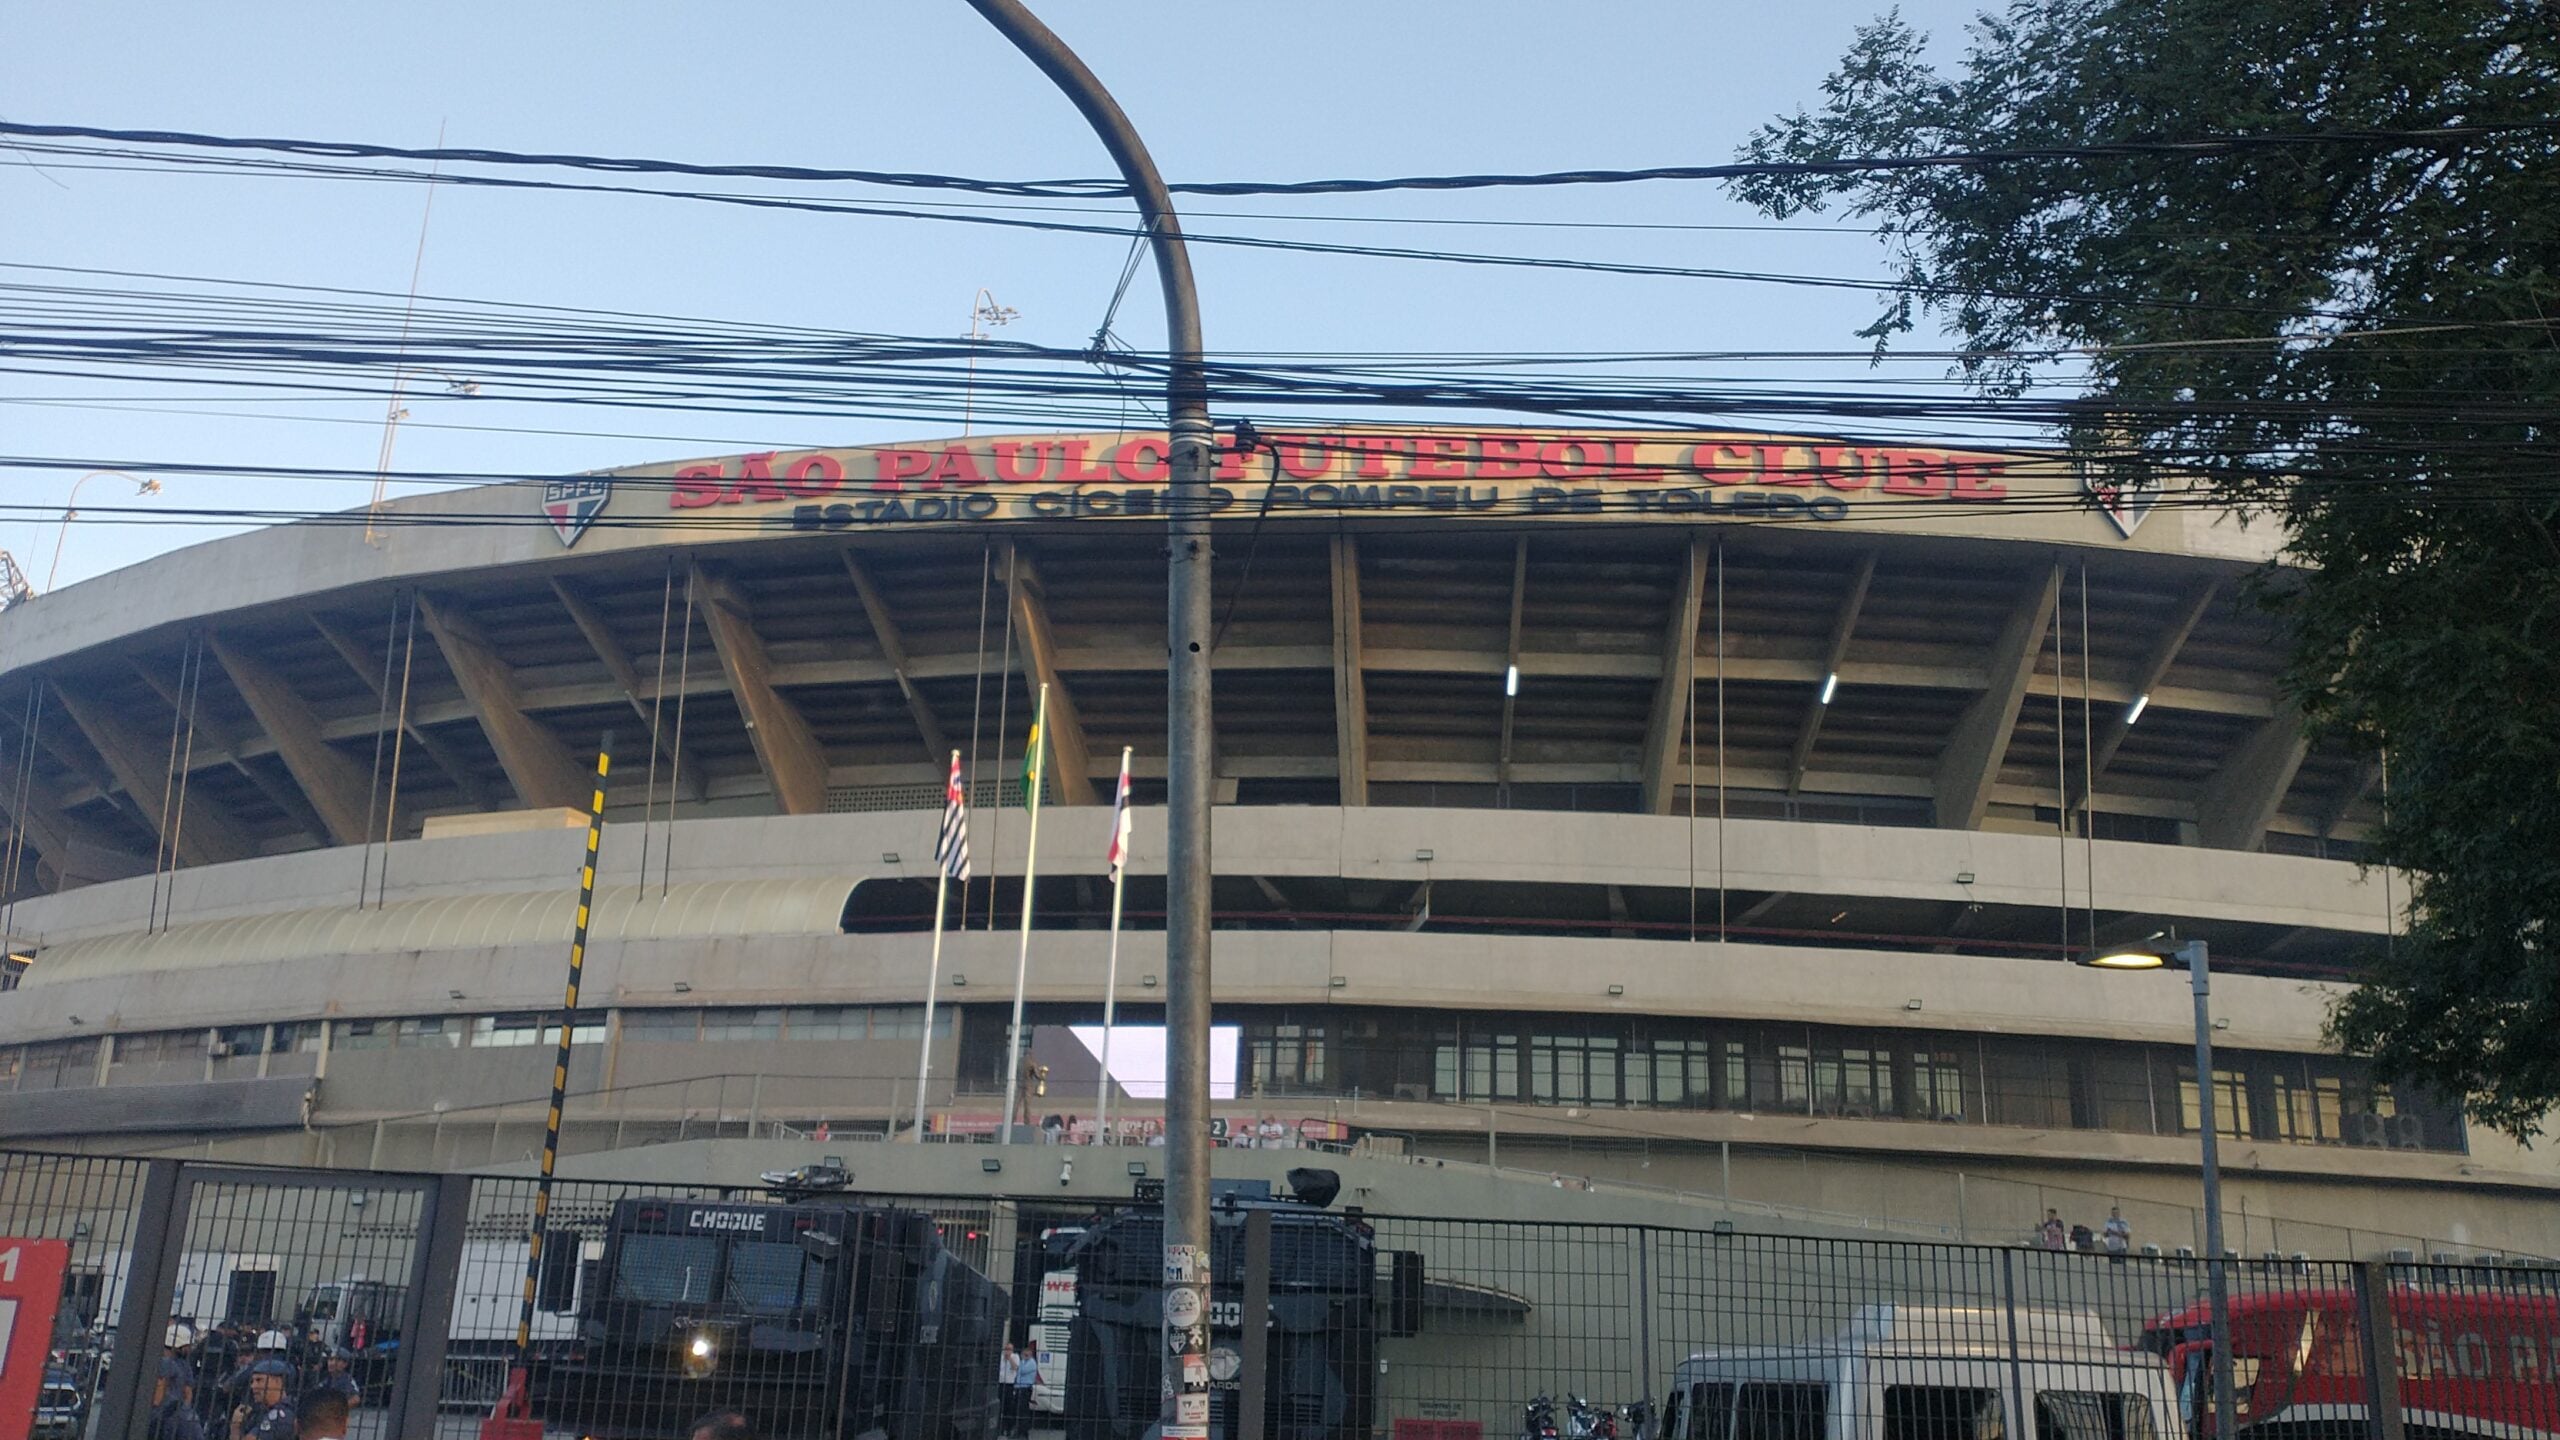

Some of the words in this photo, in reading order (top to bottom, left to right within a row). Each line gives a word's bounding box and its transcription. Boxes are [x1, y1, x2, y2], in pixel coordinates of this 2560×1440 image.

[670, 450, 845, 508] SÃO
[871, 438, 1171, 491] PAULO
[1216, 433, 1663, 482] FUTEBOL
[1692, 441, 2007, 500] CLUBE
[1267, 483, 1498, 510] POMPEU
[1531, 486, 1603, 512] DE
[1627, 489, 1849, 521] TOLEDO
[1212, 1121, 1222, 1135] 2
[689, 1210, 766, 1232] CHOQUE
